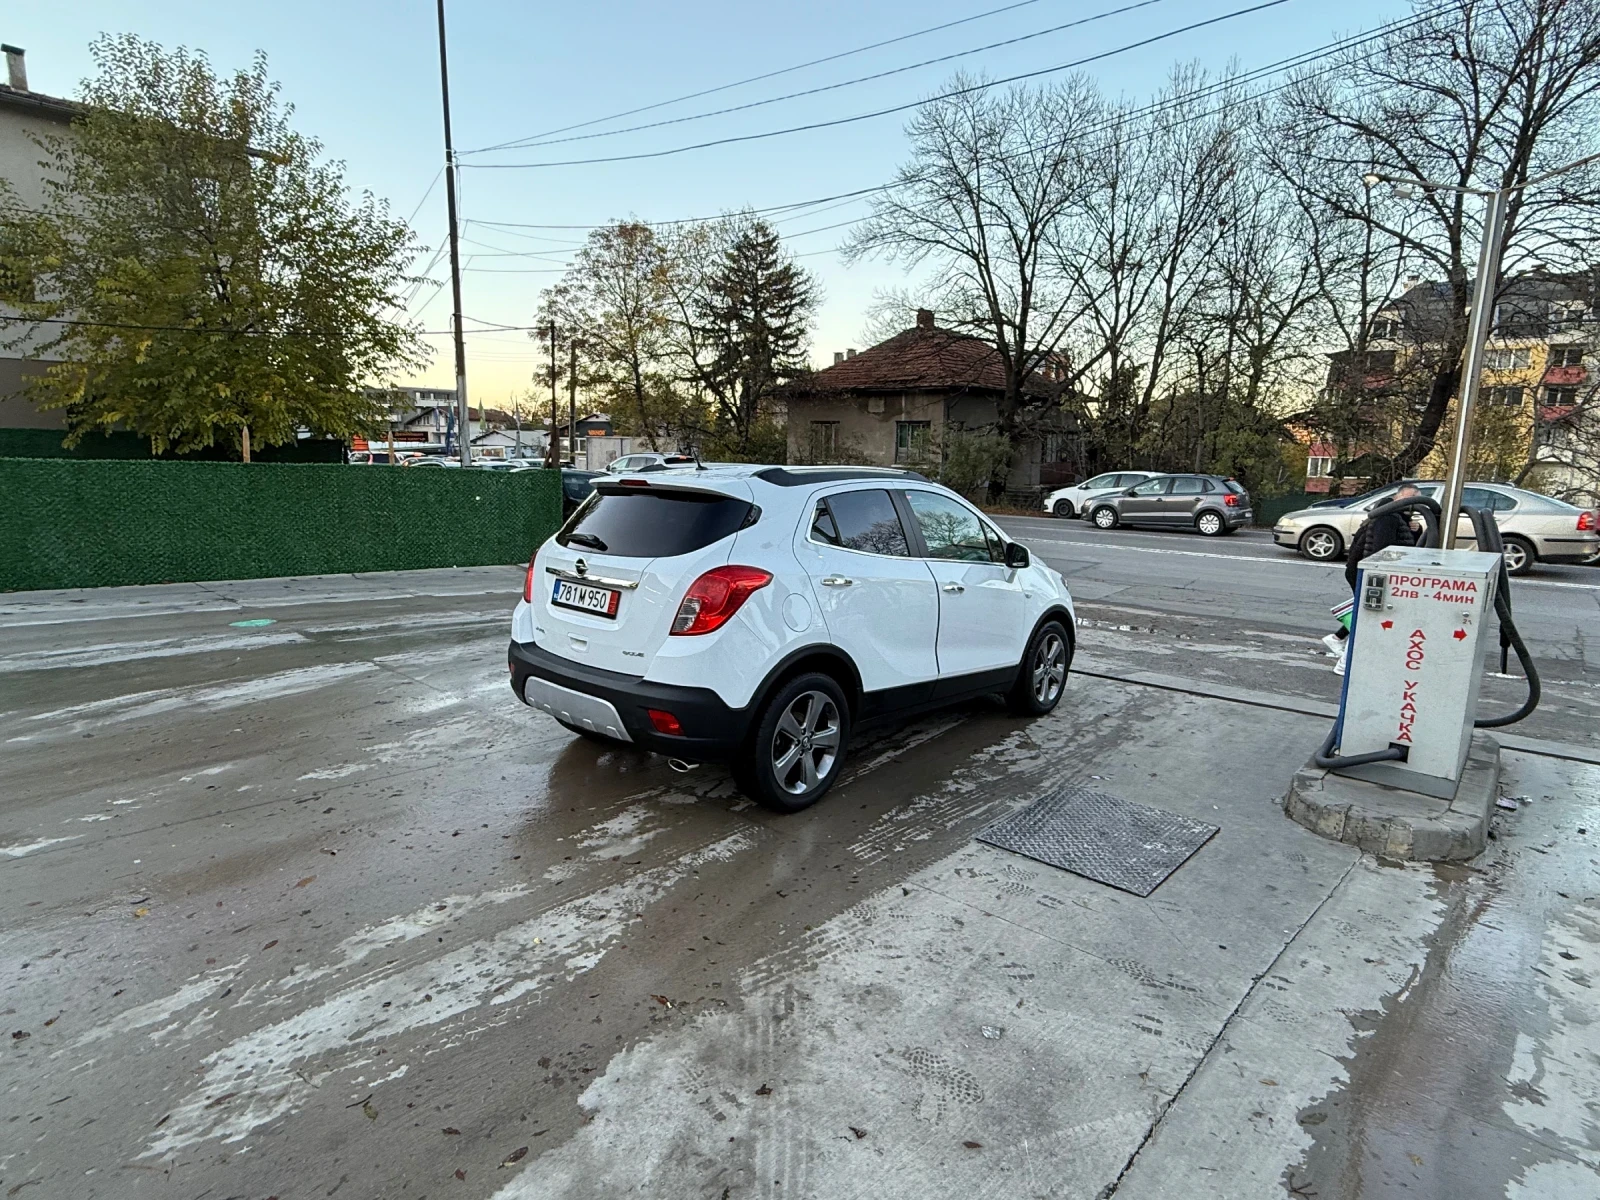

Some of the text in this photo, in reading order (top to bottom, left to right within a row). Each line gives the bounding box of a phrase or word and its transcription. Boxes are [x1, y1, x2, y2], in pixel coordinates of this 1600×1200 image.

[1388, 574, 1478, 593] ПРОГРАМА
[1391, 587, 1419, 599] 2лв
[1432, 591, 1475, 604] 4мин
